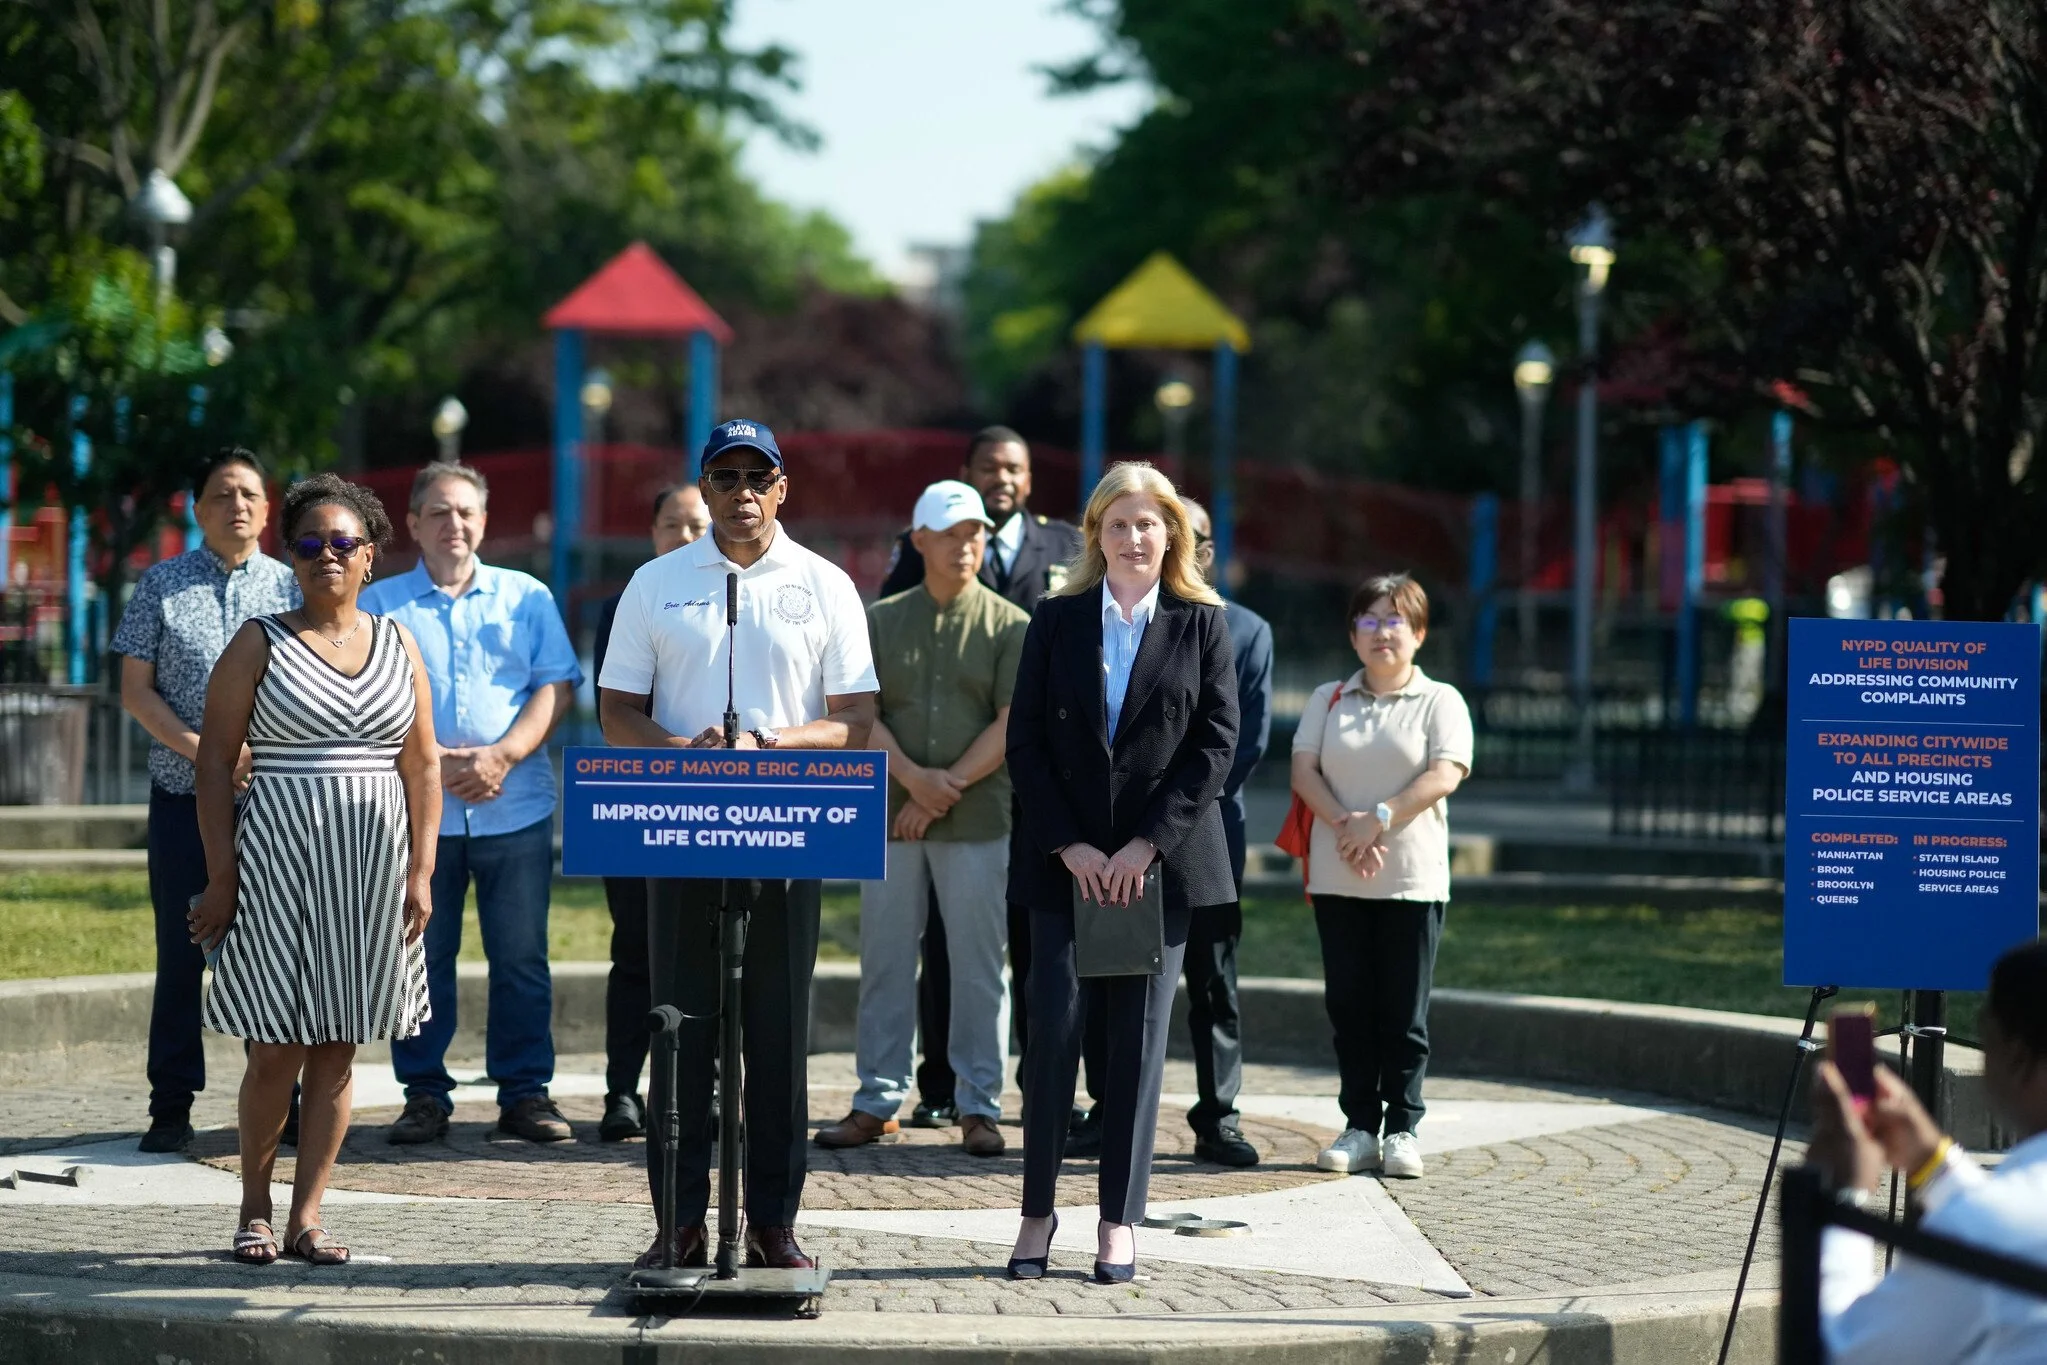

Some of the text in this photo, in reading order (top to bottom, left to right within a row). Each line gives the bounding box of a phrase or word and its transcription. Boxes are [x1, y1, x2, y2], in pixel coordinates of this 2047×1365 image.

[727, 430, 757, 438] ADAMS
[664, 602, 680, 610] Eric
[1842, 640, 1986, 654] NYPD QUALITY OF
[1860, 657, 1968, 670] LIFE DIVISION
[1809, 674, 2018, 689] ADDRESSING COMMUNITY
[1861, 692, 1966, 705] COMPLAINTS
[1818, 733, 2008, 750] EXPANDING CITYWIDE
[1833, 752, 1992, 768] TO ALL PRECINCTS
[576, 759, 874, 777] OFFICE OF MAYOR ERIC ADAMS
[1852, 771, 1972, 785] AND HOUSING
[1813, 789, 2012, 805] POLICE SERVICE AREAS
[593, 804, 857, 825] IMPROVING QUALITY OF
[644, 829, 805, 847] LIFE CITYWIDE
[1812, 833, 1898, 844] COMPLETED:
[1914, 835, 2007, 847] IN PROGRESS:
[1818, 851, 1883, 860] MANHATTAN
[1919, 854, 1999, 863] STATEN ISLAND
[1818, 866, 1853, 874] BRONX
[1919, 869, 2006, 878] HOUSING POLICE
[1817, 881, 1874, 889] BROOKLYN
[1919, 884, 1999, 893] SERVICE AREAS
[1817, 895, 1858, 904] QUEENS
